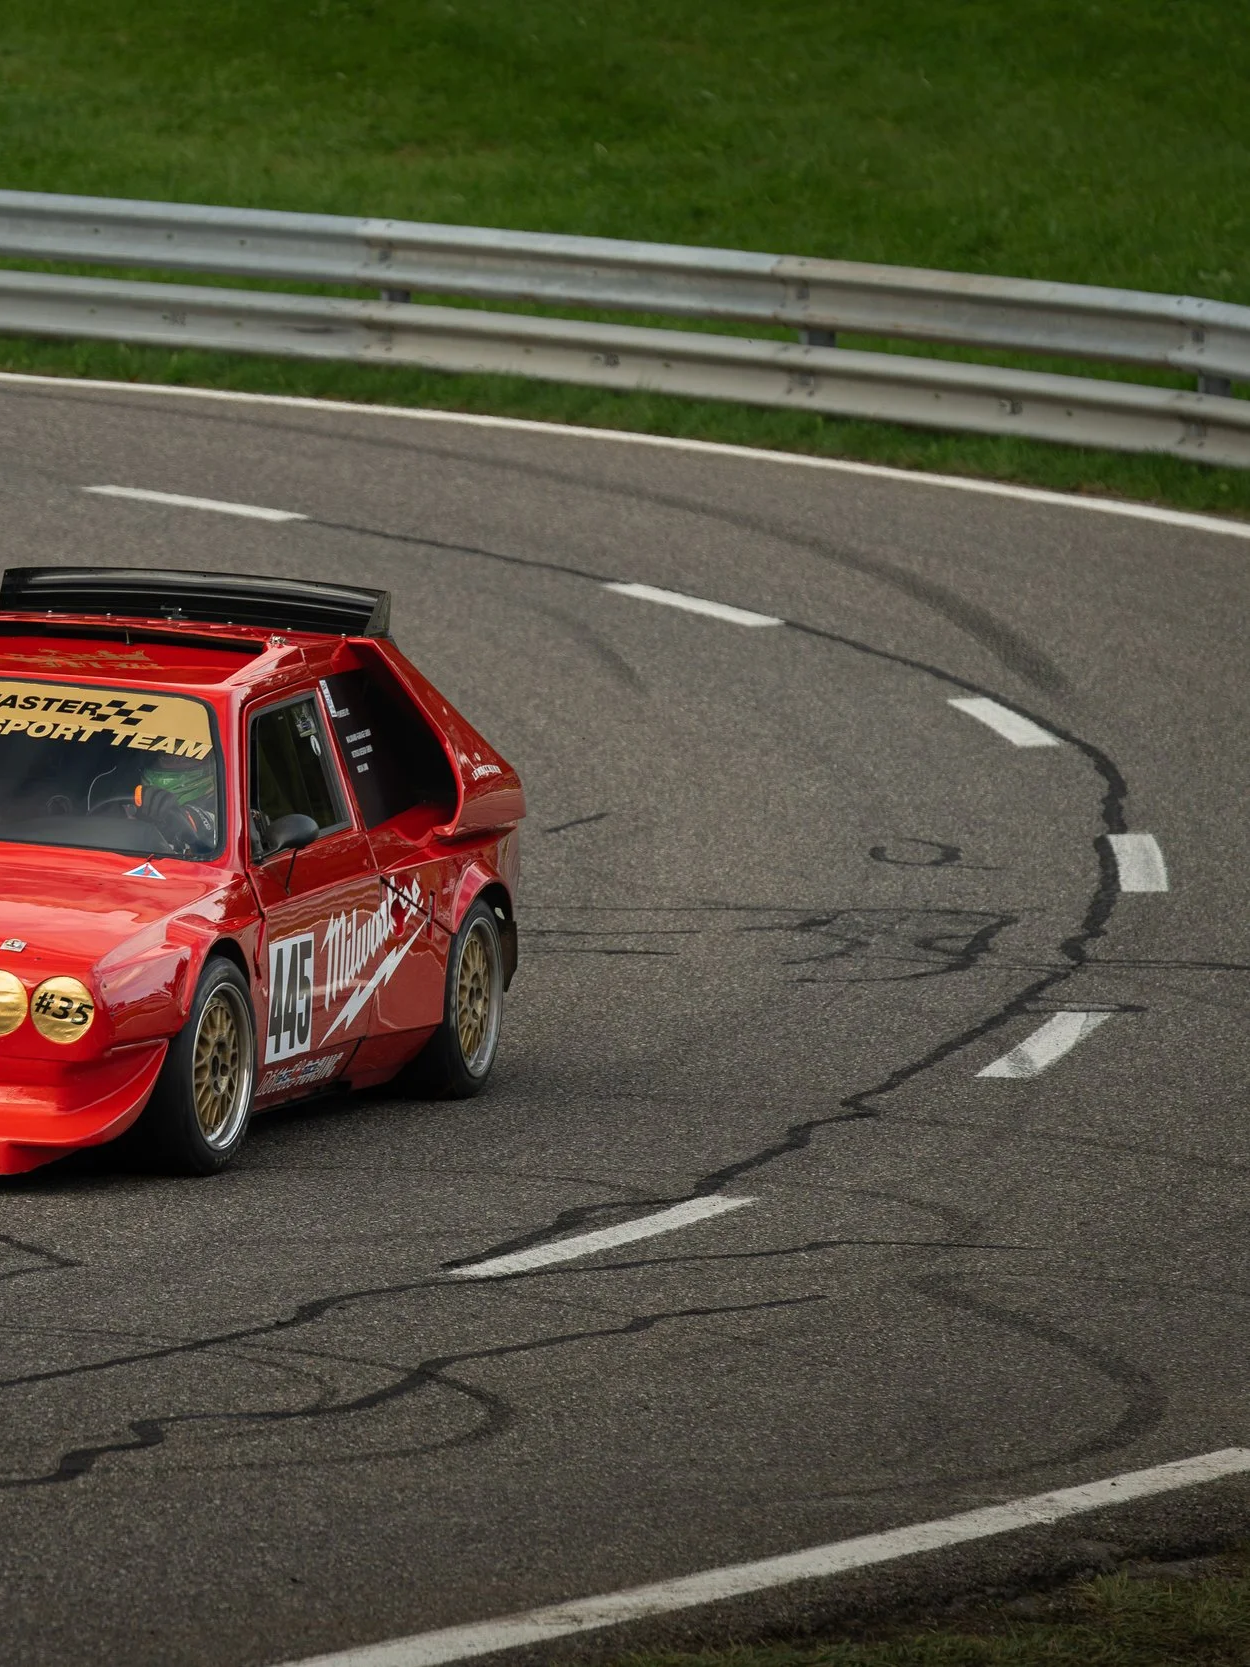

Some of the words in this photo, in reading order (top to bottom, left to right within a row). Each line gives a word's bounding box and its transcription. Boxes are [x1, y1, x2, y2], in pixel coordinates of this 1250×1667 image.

[108, 727, 213, 760] TEAM
[34, 990, 95, 1026] #35
[268, 939, 313, 1055] 445
